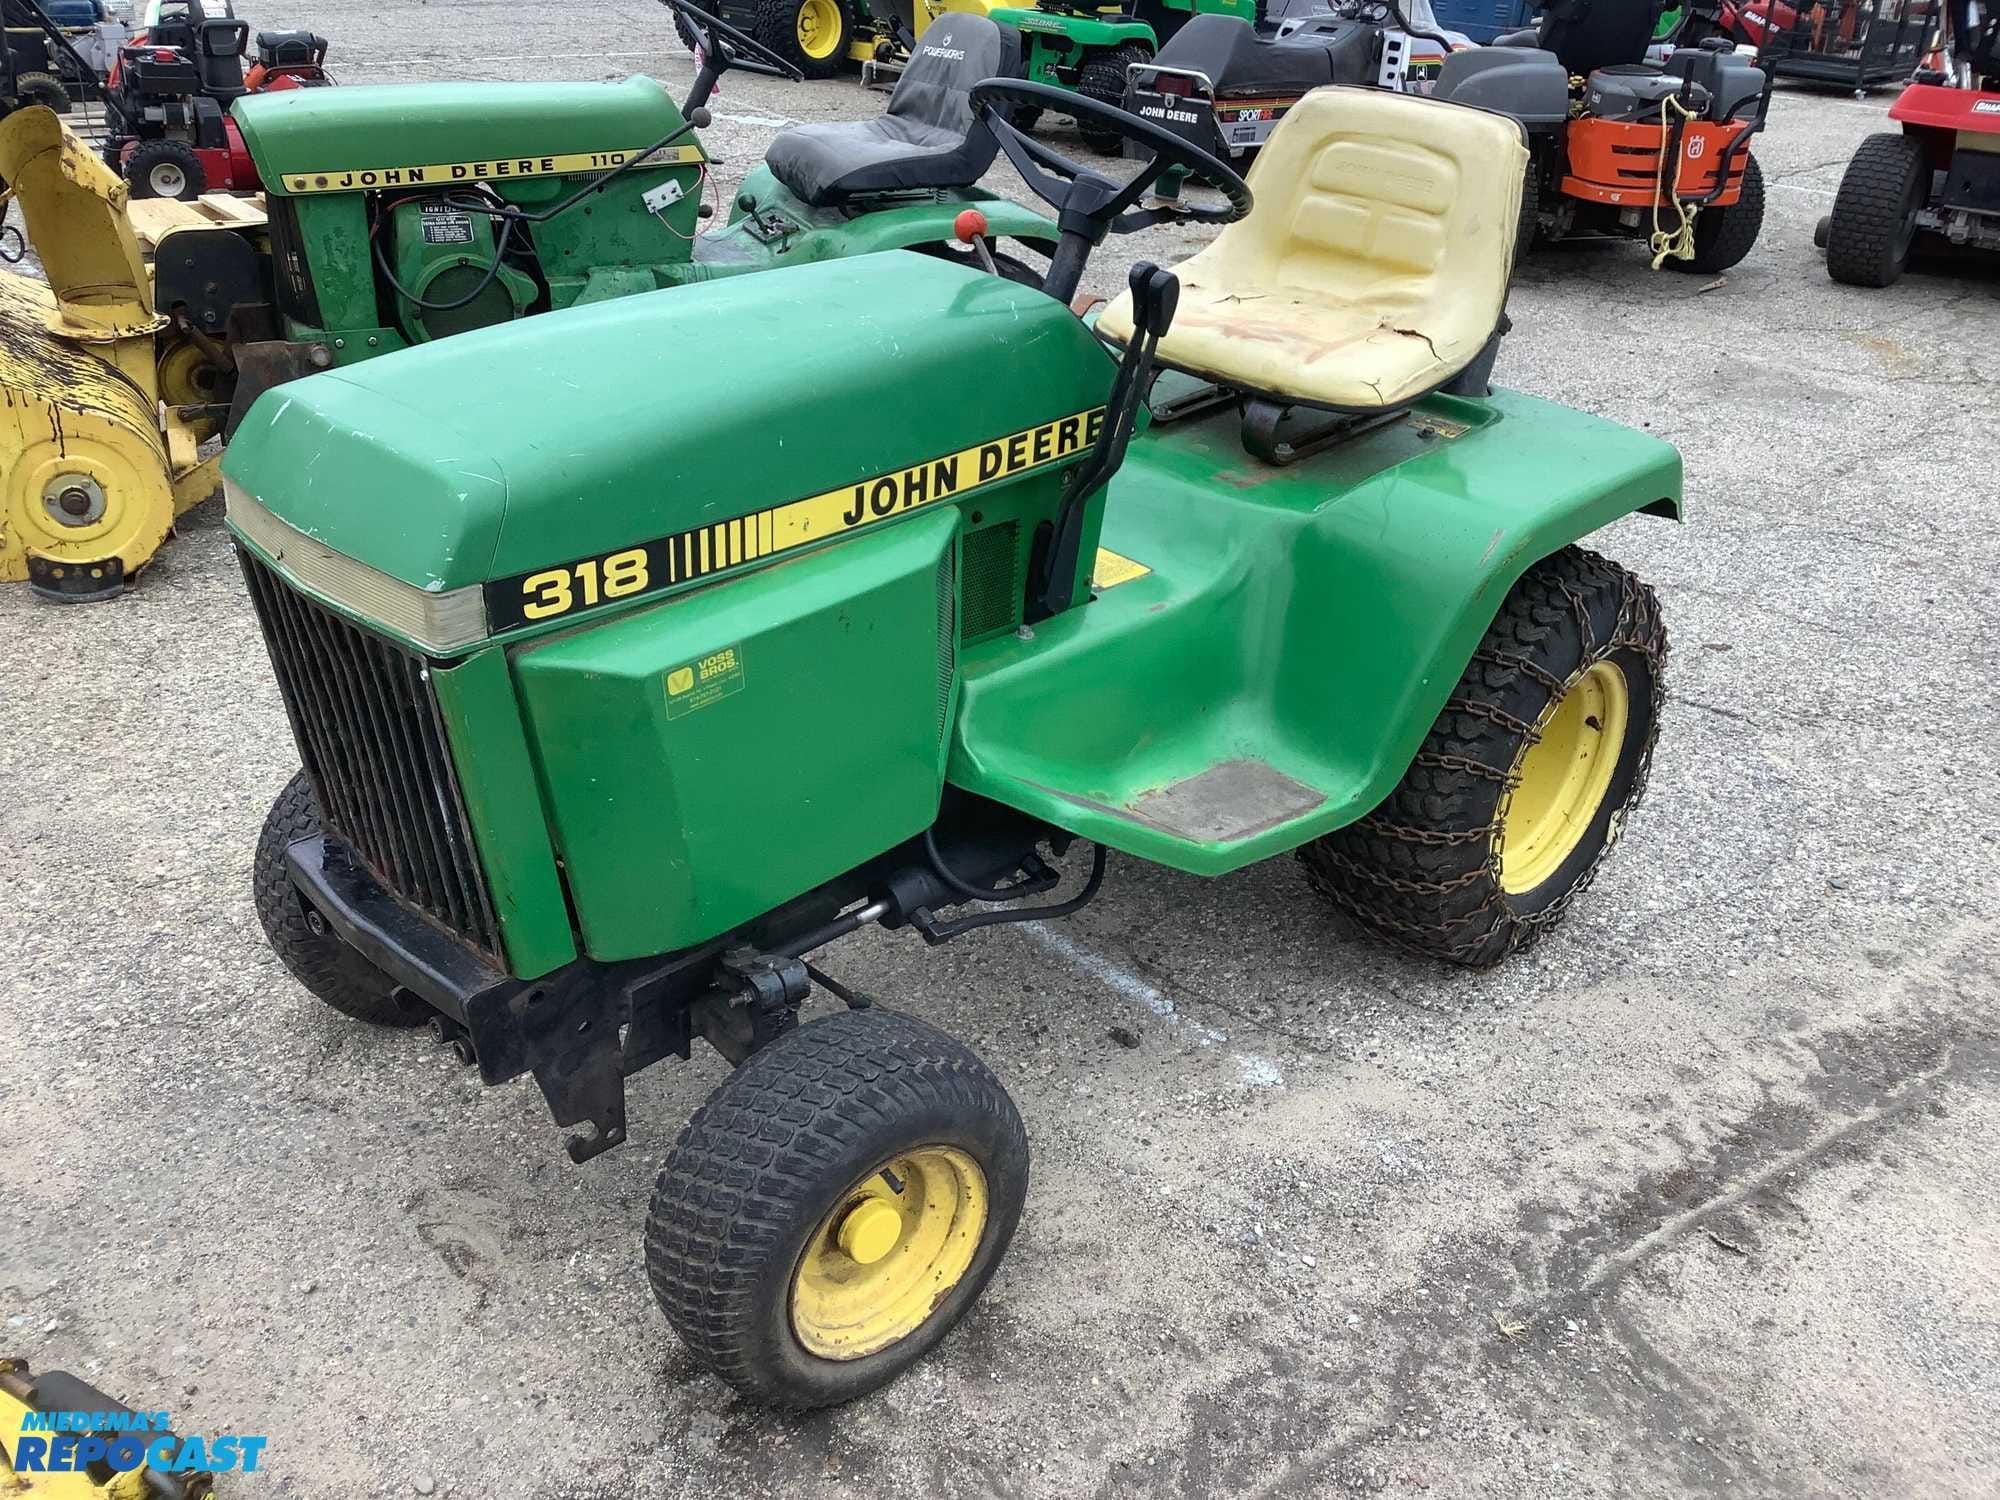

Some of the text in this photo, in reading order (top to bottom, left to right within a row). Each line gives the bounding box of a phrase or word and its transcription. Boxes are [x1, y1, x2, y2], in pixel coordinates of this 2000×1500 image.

[1140, 106, 1198, 124] JOHN DEERE
[340, 168, 425, 188] JOHN
[451, 157, 555, 179] DEERE
[590, 152, 625, 167] 110
[522, 411, 1105, 619] 318 JOHN DEERE
[698, 649, 734, 670] VOSS
